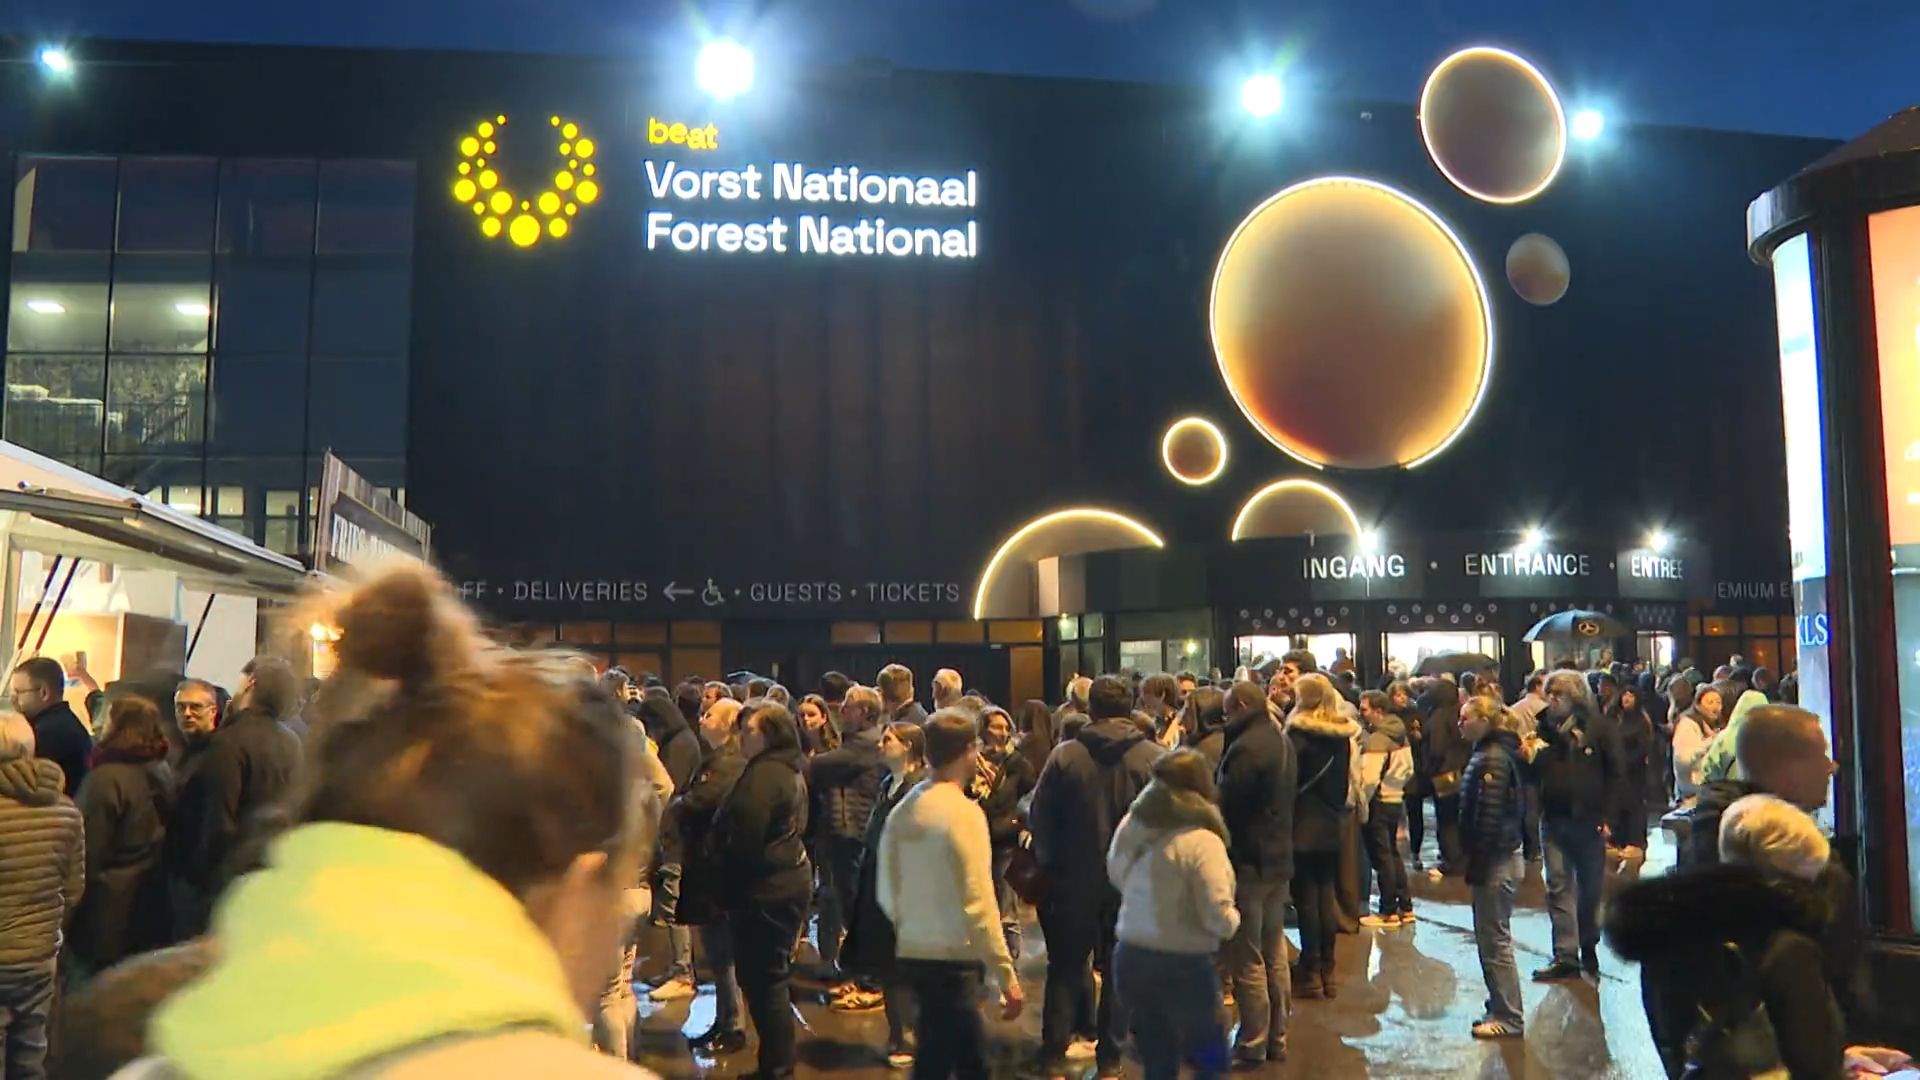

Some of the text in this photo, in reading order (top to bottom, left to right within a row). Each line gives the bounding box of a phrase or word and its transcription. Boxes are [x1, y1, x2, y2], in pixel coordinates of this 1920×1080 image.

[647, 117, 719, 150] beat
[644, 160, 977, 208] Vorst Nationaal
[645, 210, 977, 259] Forest National
[1303, 554, 1405, 579] INGANG
[1465, 553, 1590, 576] ENTRANCE
[513, 580, 649, 602] DELIVERIES
[750, 582, 842, 602] GUESTS
[867, 582, 960, 602] TICKETS
[1713, 581, 1774, 600] EMIUM
